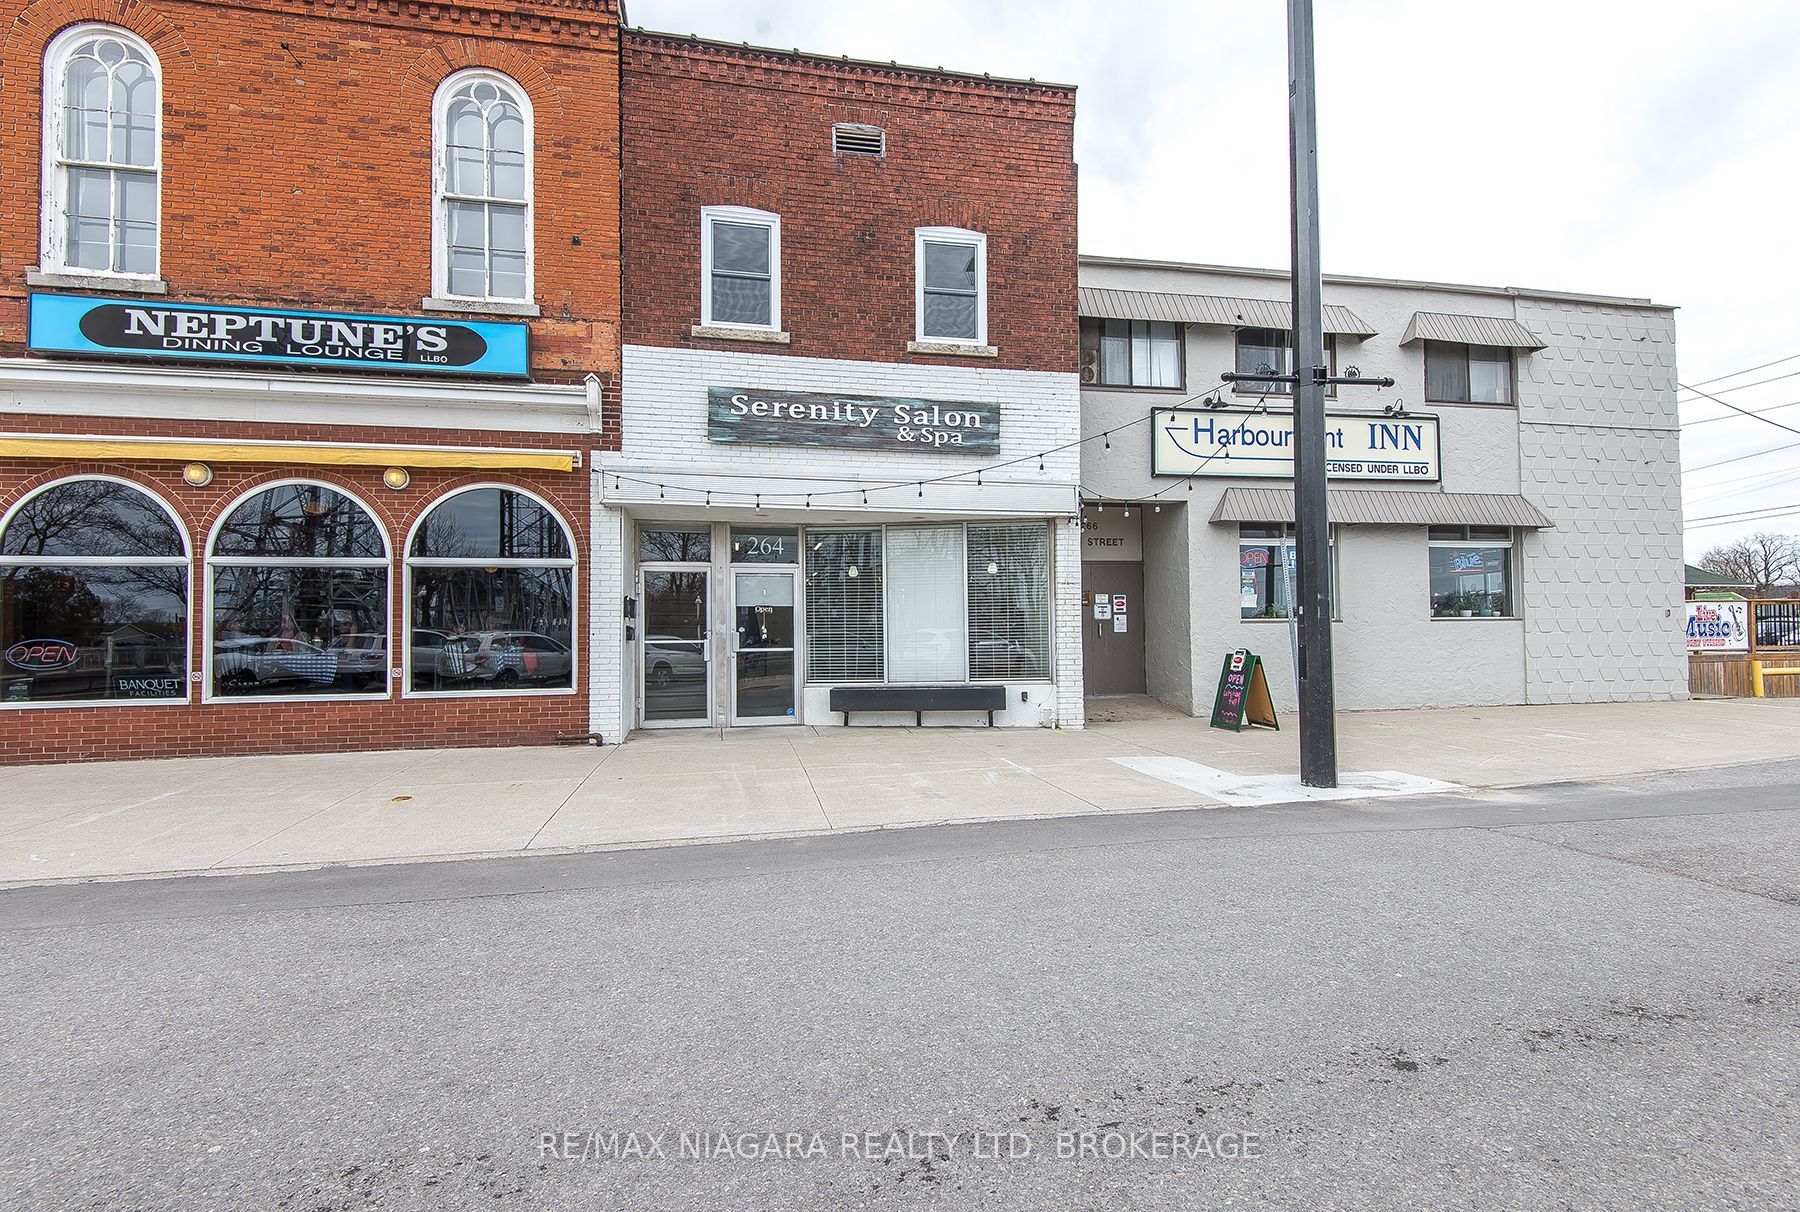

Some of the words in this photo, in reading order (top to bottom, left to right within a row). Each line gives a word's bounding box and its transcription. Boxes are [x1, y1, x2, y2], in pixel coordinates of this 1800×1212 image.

[124, 308, 448, 352] NEPTUNE'S
[162, 337, 263, 353] DINING
[286, 343, 403, 361] LOUNGE
[420, 354, 448, 364] LLBO
[730, 394, 880, 428] Serenity
[893, 403, 983, 428] Salon
[896, 426, 917, 442] &
[920, 427, 964, 448] Spa
[1194, 417, 1344, 449] Harbournt
[1367, 422, 1424, 451] INN
[1326, 462, 1363, 473] CENSED
[1367, 463, 1399, 474] UNDER
[1403, 464, 1429, 475] LLBO
[747, 536, 785, 556] 264
[1087, 537, 1125, 547] STREET
[1239, 551, 1269, 565] OPEN
[754, 605, 774, 614] Open
[9, 646, 78, 662] OPEN
[119, 679, 181, 691] BANQUET
[1227, 673, 1245, 685] OPEN
